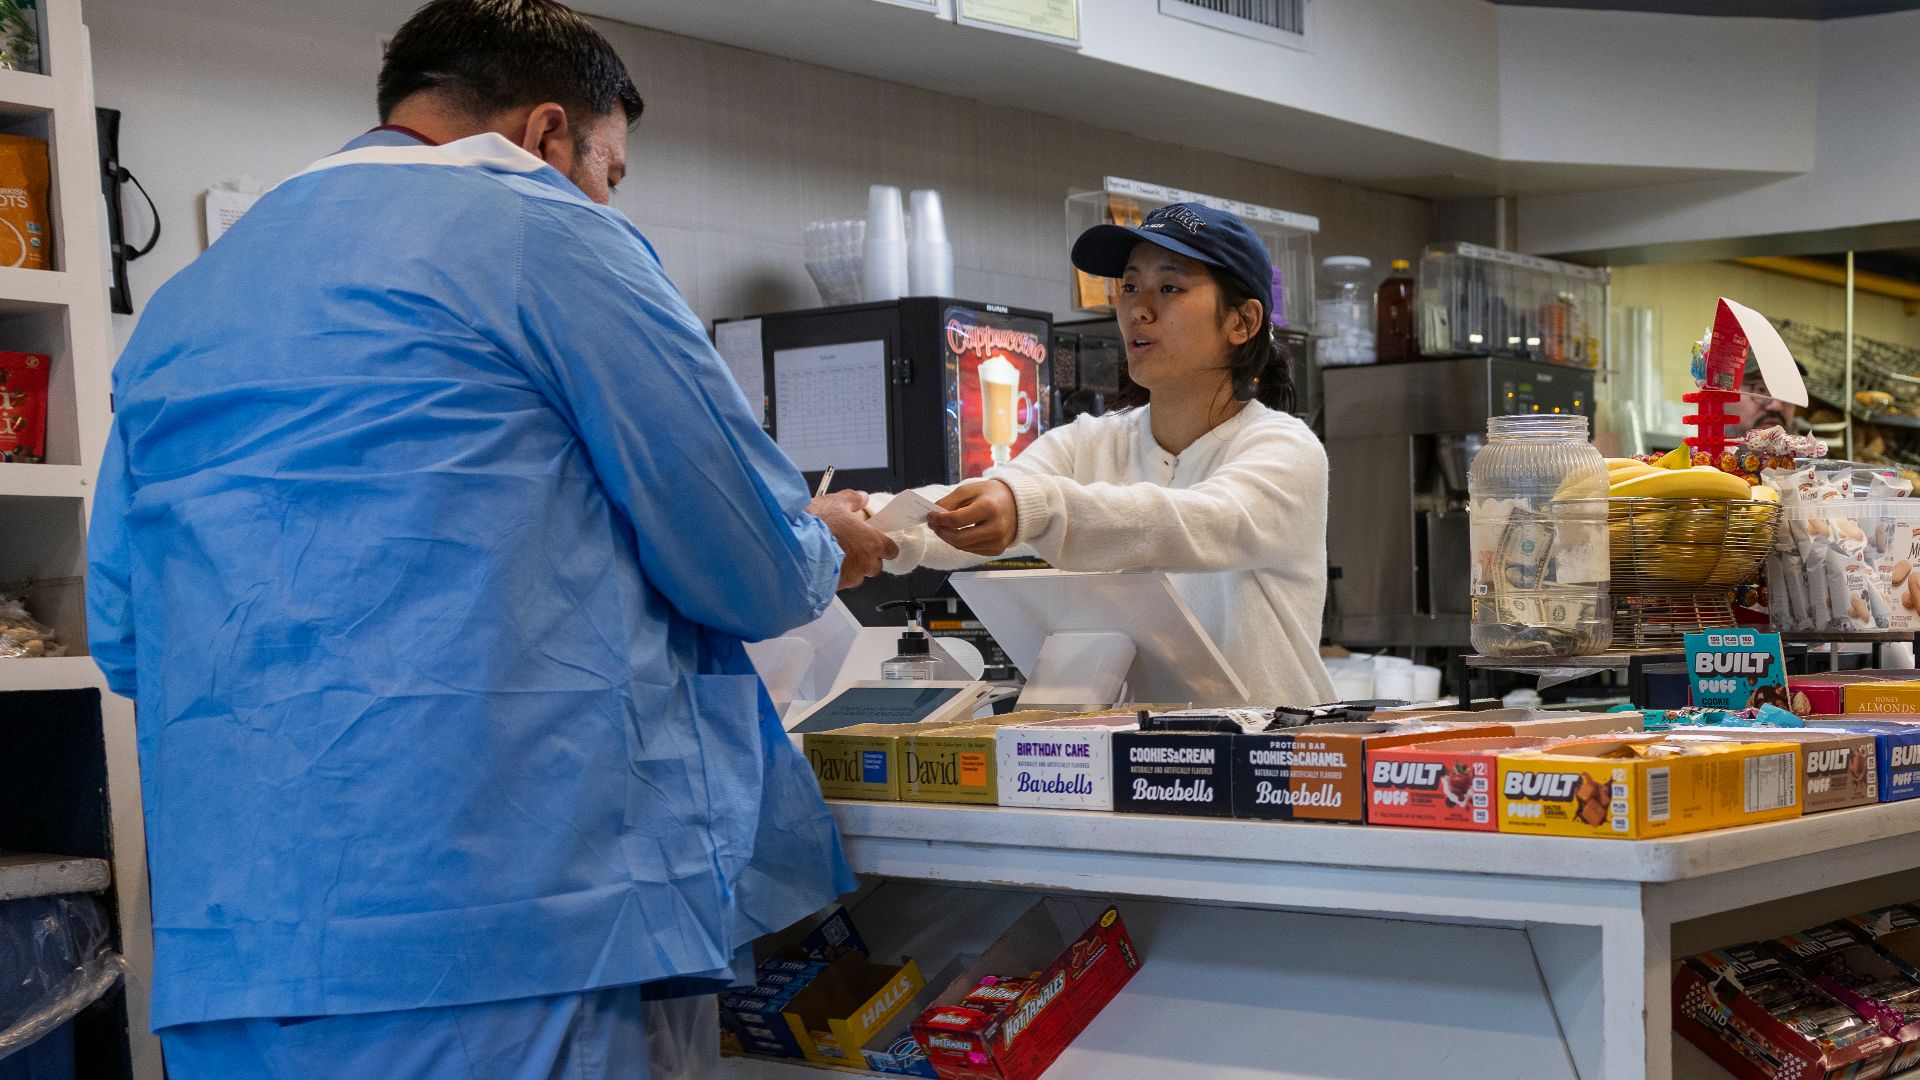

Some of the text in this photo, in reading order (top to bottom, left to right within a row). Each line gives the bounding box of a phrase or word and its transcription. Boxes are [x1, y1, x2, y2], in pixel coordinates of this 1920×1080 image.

[986, 304, 1008, 314] BUNN
[947, 319, 1046, 363] Cappuccino
[1695, 653, 1769, 673] BUILT
[1699, 679, 1736, 693] PUFF
[1702, 697, 1730, 706] COOKIE
[1858, 703, 1916, 713] ALMONDS
[1017, 742, 1090, 758] BIRTHDAY CAKE
[1270, 741, 1305, 749] PROTEIN
[1130, 747, 1215, 764] COOKIES&CREAM
[1249, 750, 1347, 767] COOKIES&CARAMEL
[1807, 743, 1873, 772] BUILT 12
[810, 749, 860, 782] David
[906, 752, 958, 785] David
[1280, 769, 1289, 777] AND
[1373, 761, 1485, 785] BUILT 12
[1017, 772, 1092, 794] Barebells
[1504, 771, 1580, 797] BUILT
[1808, 778, 1830, 795] PUFF
[1893, 772, 1912, 786] PUFF
[1132, 777, 1213, 802] Barebells
[1256, 781, 1342, 807] Barebells
[1373, 790, 1409, 806] PUFF
[1508, 802, 1542, 818] PUFF
[1791, 941, 1827, 957] KIND
[781, 962, 807, 970] HALLS
[752, 987, 780, 995] HALLS
[738, 1000, 766, 1009] HALLS
[861, 975, 911, 1029] HALLS
[1003, 970, 1065, 1050] HOT TAMALES
[1699, 1002, 1727, 1026] KIND
[929, 1036, 972, 1050] HOT TAMALES
